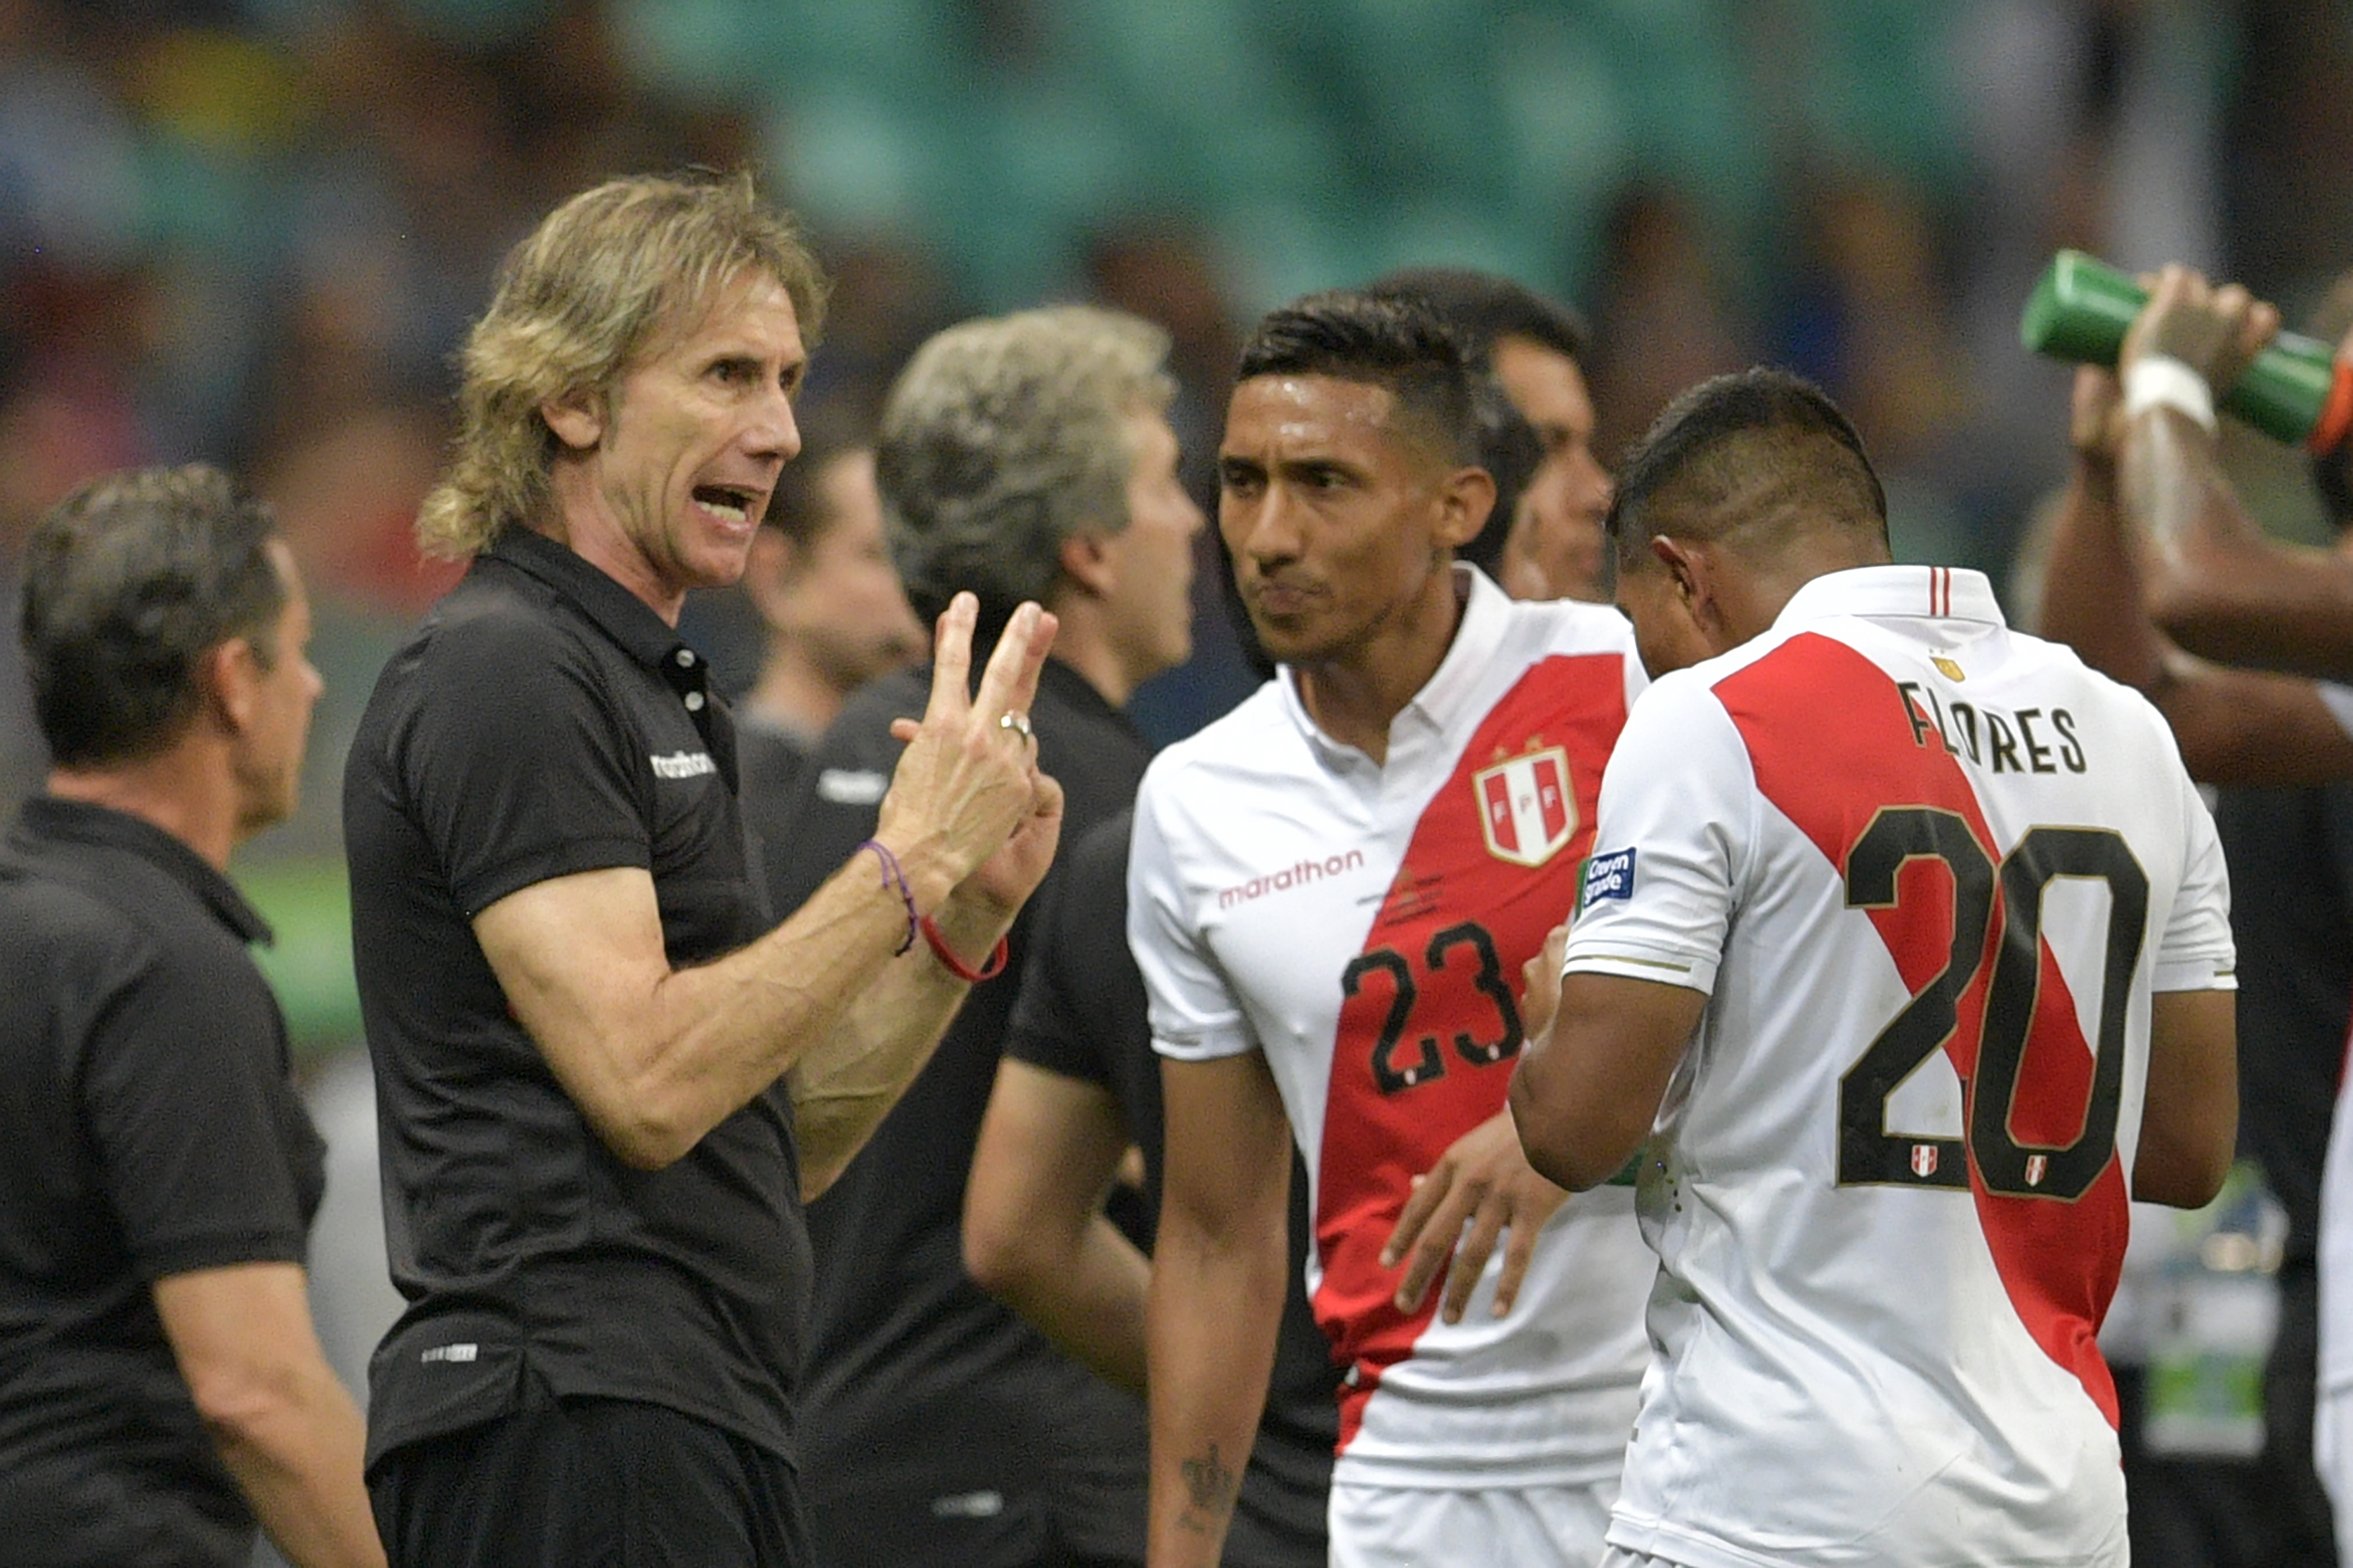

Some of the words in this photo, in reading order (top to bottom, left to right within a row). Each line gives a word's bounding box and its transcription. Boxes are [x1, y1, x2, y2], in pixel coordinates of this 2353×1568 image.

[1896, 680, 2087, 775] FLORES
[1218, 850, 1364, 910] marathon
[1341, 921, 1523, 1096] 23
[1837, 806, 2149, 1202] 20
